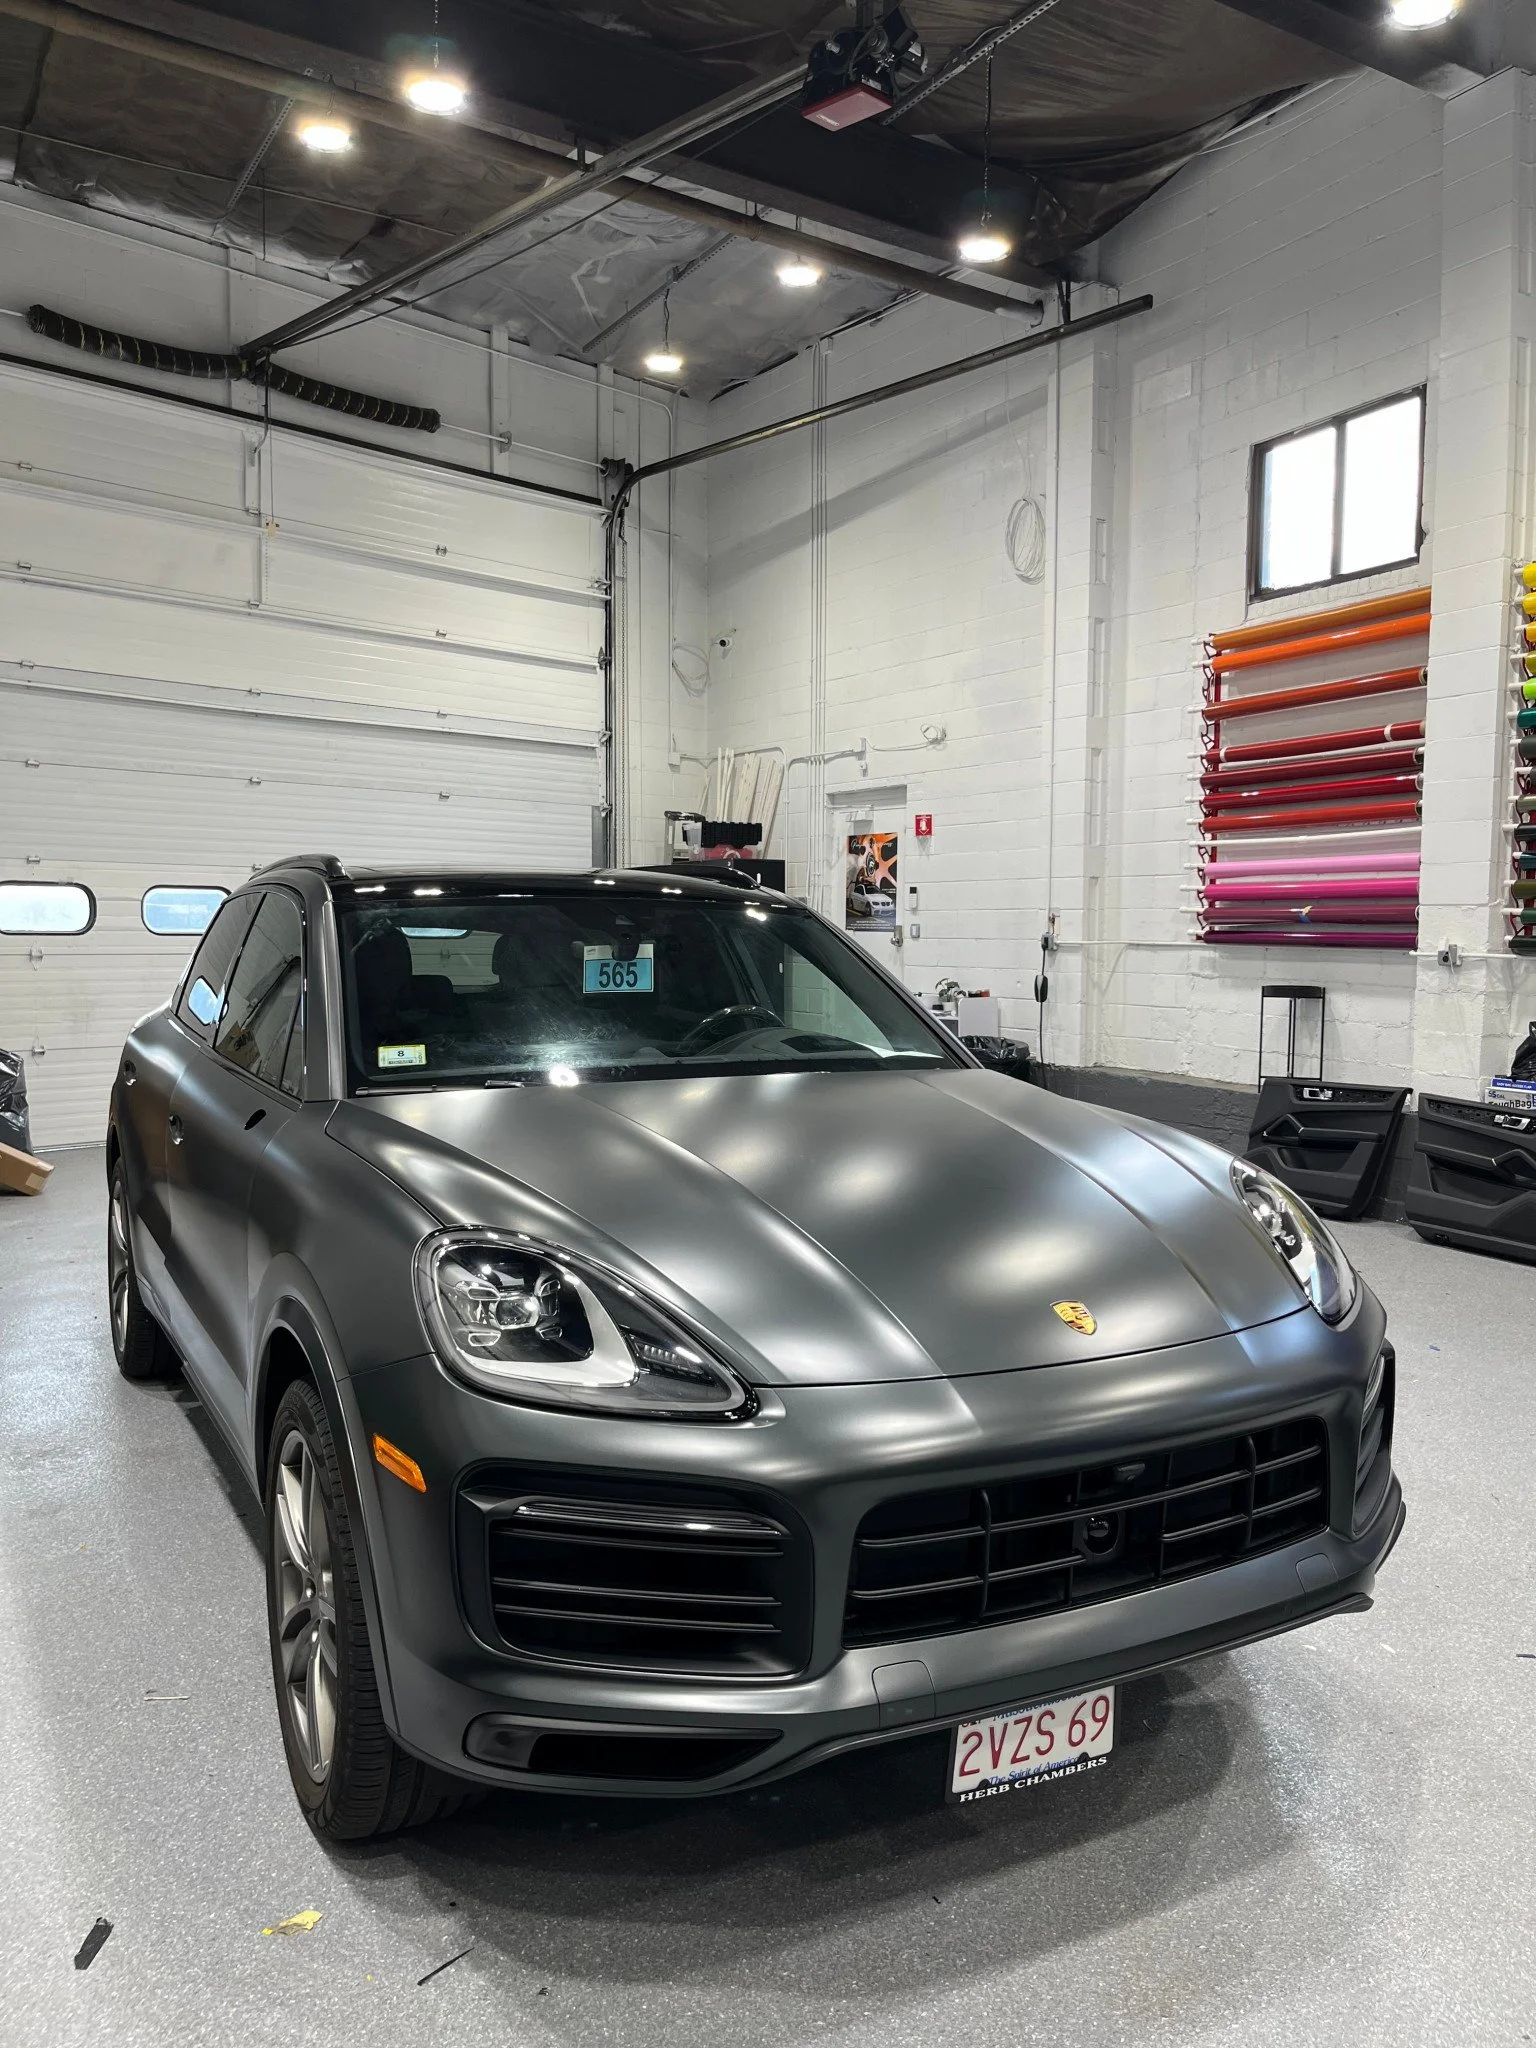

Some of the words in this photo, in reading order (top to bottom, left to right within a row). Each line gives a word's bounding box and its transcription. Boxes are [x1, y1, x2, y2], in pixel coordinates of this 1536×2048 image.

[599, 962, 638, 988] 565
[959, 1710, 1056, 1777] 2VZS
[1068, 1695, 1110, 1747] 69
[960, 1783, 1010, 1803] HERB
[1014, 1756, 1108, 1790] CHAMBERS
[989, 1775, 1006, 1786] The
[1008, 1767, 1031, 1781] Spirit
[1034, 1763, 1044, 1774] of
